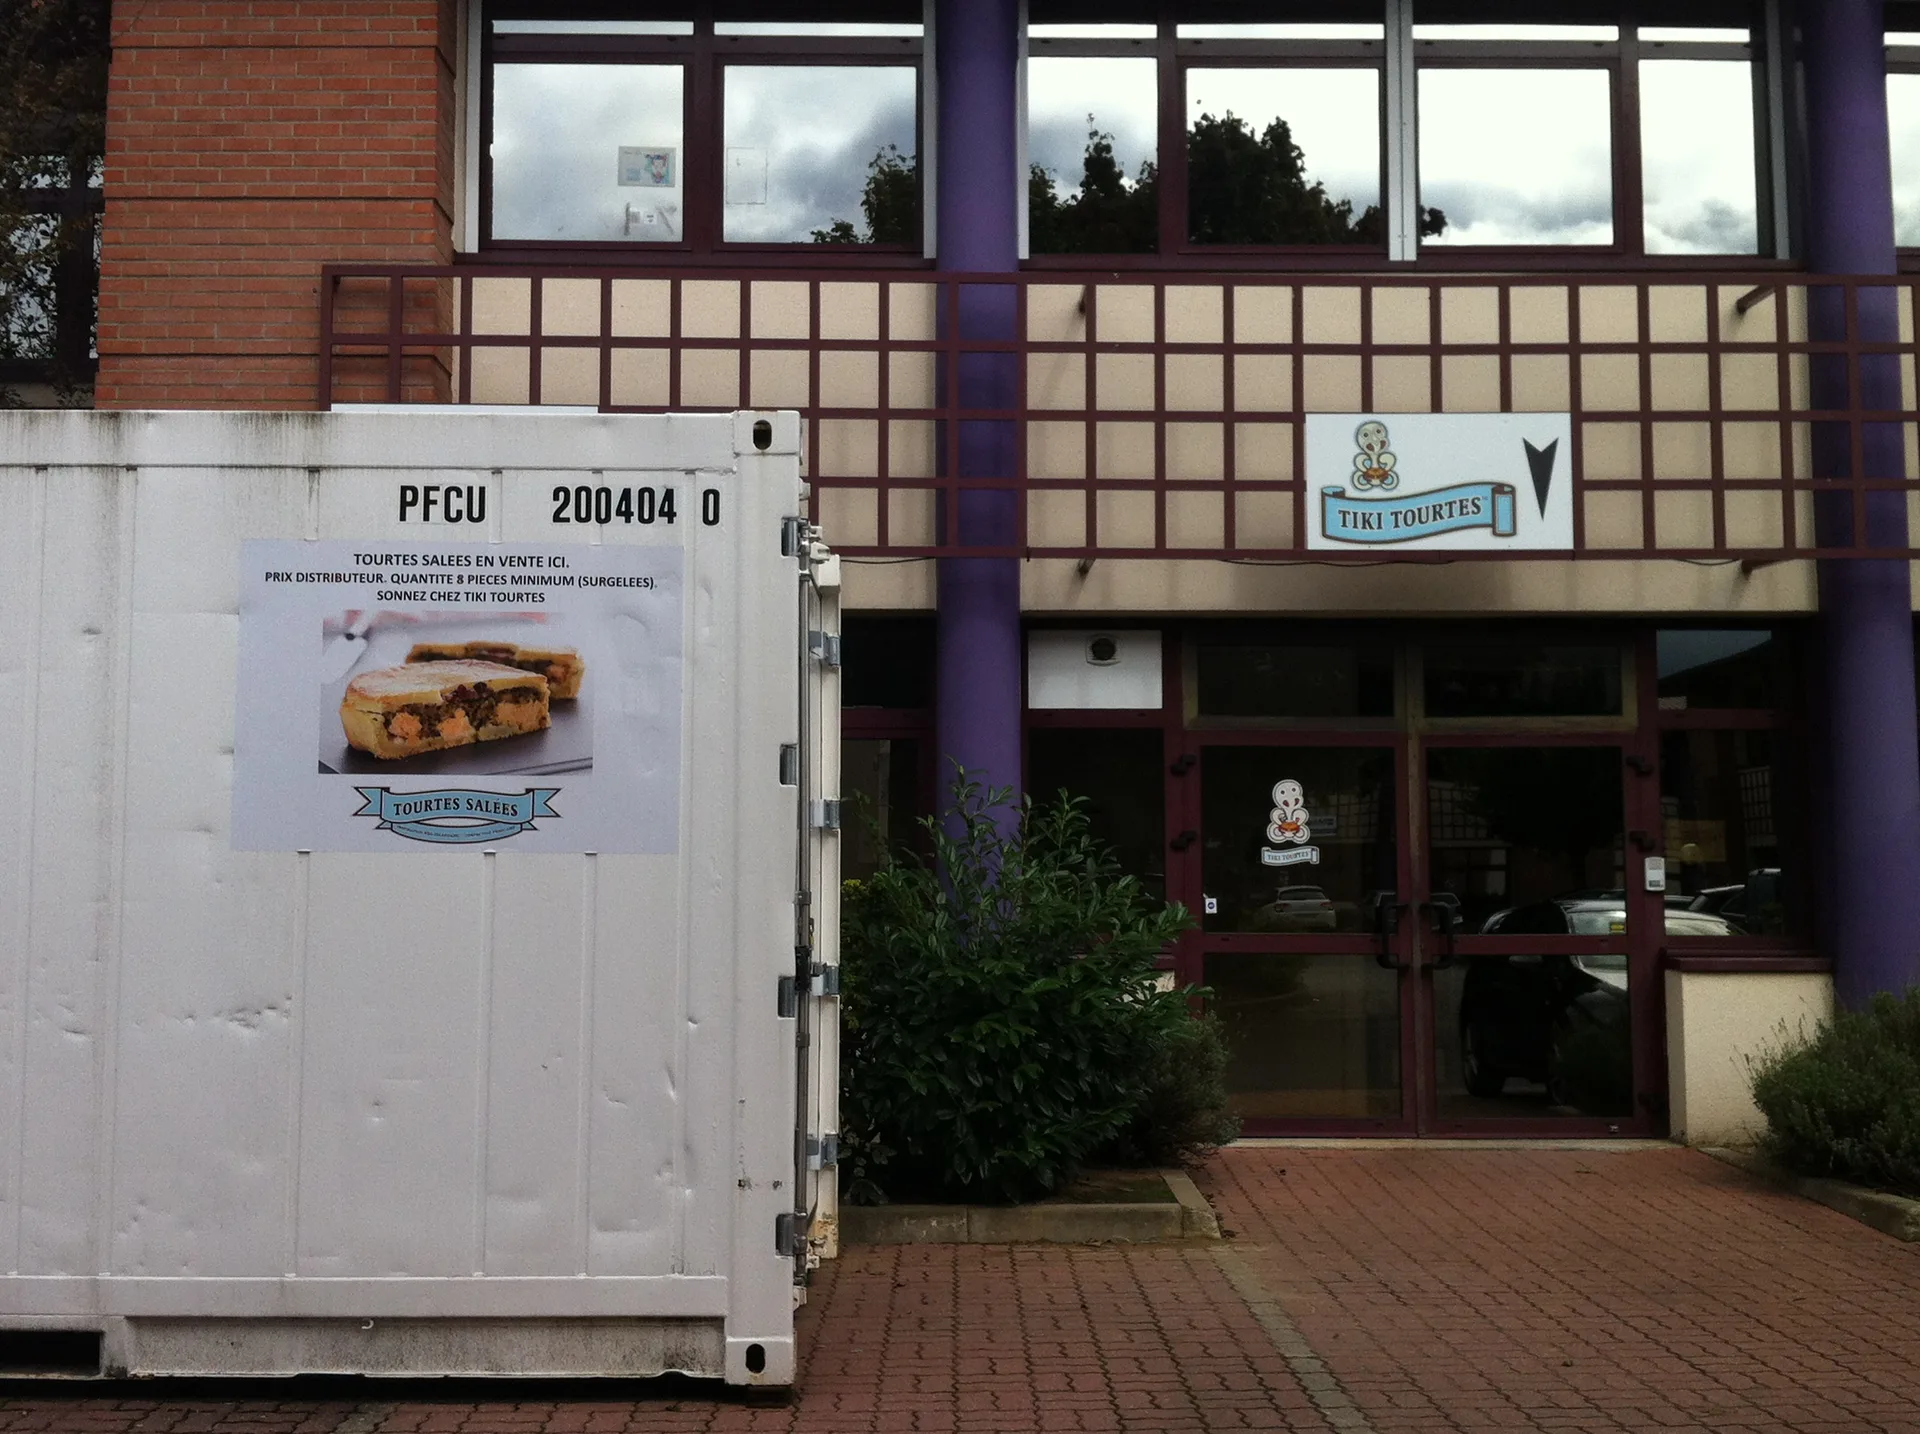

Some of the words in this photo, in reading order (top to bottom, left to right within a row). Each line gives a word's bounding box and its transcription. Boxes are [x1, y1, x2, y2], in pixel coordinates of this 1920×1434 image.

[399, 485, 486, 523] PFCU
[552, 485, 677, 524] 200404
[1338, 509, 1383, 530] TIKI
[1390, 496, 1482, 529] TOURTES
[354, 553, 418, 566] TOURTES
[422, 554, 472, 567] SALEES
[476, 555, 494, 567] EN
[498, 555, 544, 568] VENTE
[548, 556, 570, 569] ICI.
[265, 572, 292, 583] PRIX
[296, 572, 388, 584] DISTRIBUTEUR.
[390, 573, 453, 585] QUANTITE
[456, 574, 465, 585] 8
[468, 574, 507, 586] PIECES
[511, 575, 574, 587] MINIMUM
[578, 575, 659, 590] (SURGELEES).
[377, 590, 426, 602] SONNEZ
[430, 591, 461, 603] CHEZ
[464, 591, 487, 603] TIKI
[490, 592, 546, 604] TOURTES
[393, 797, 461, 816] TOURTES
[466, 797, 519, 817] SALÉES
